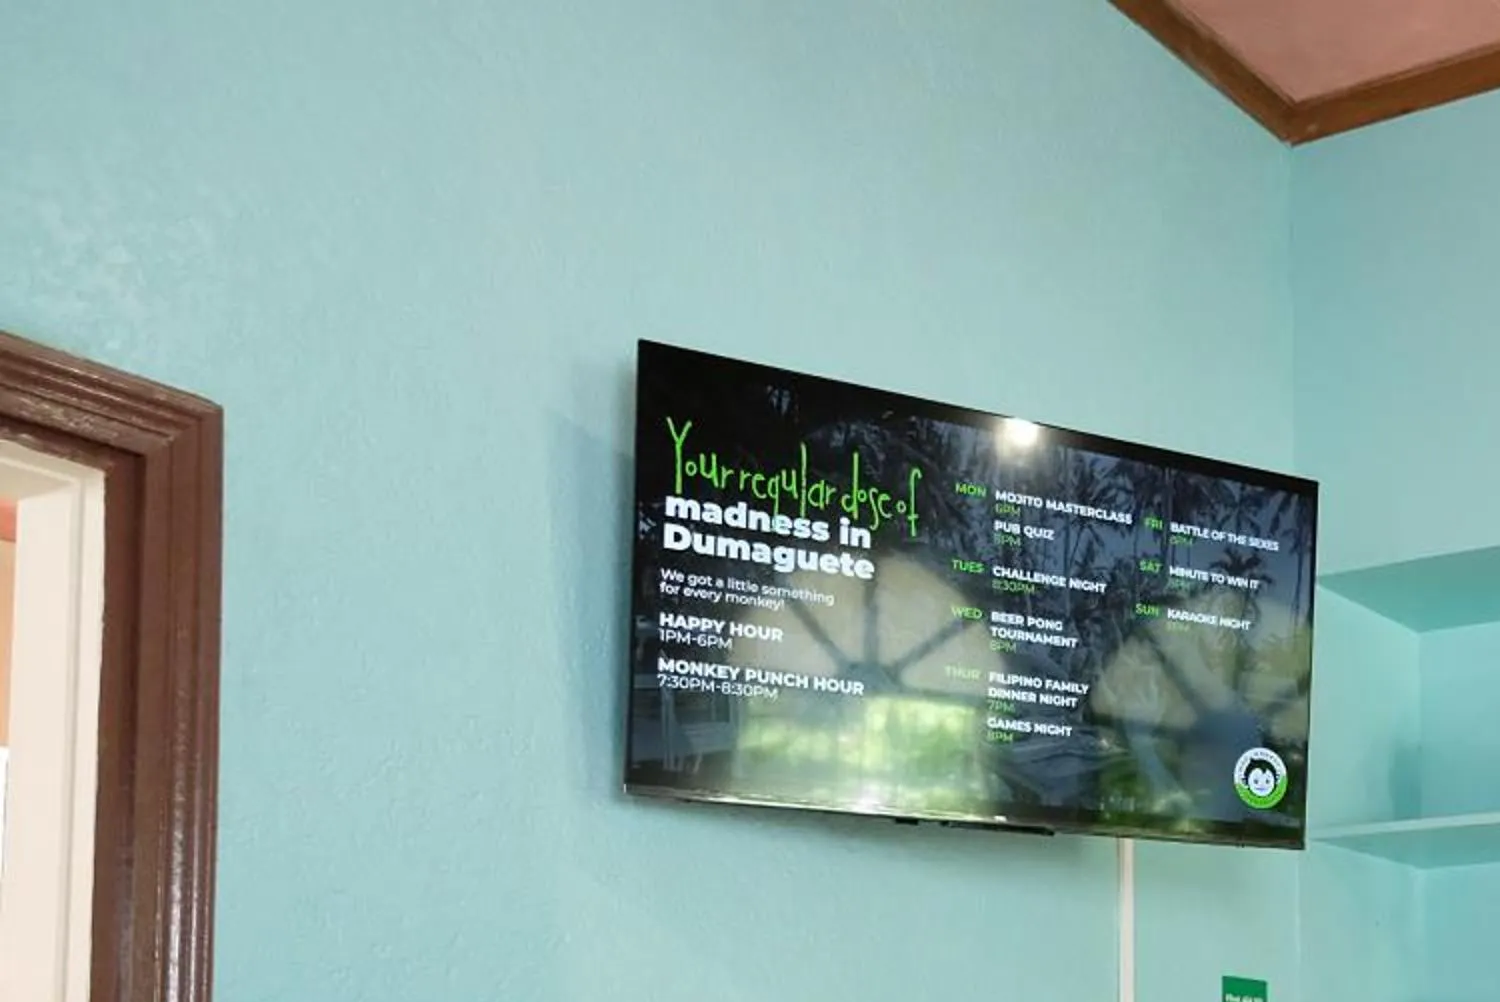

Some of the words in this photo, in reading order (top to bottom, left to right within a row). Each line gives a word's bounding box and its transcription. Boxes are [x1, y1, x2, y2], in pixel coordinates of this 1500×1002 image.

[666, 416, 734, 494] Your
[739, 441, 837, 531] regular
[841, 451, 892, 531] dose
[896, 468, 922, 537] of
[955, 482, 987, 497] MON
[995, 490, 1043, 508] MOJITO
[1045, 498, 1132, 525] MASTERCLASS
[665, 495, 830, 542] madness
[839, 516, 871, 549] in
[994, 520, 1022, 535] PUB
[1023, 524, 1056, 541] QUIZ
[1169, 521, 1209, 538] BATTLE
[1210, 530, 1226, 541] OF
[1227, 533, 1248, 545] THE
[663, 523, 875, 580] Dumaguete
[952, 559, 985, 574] TUES
[1169, 566, 1209, 582] MINUTE
[1211, 572, 1225, 584] TO
[1226, 575, 1249, 589] WIN
[660, 568, 685, 583] We
[687, 573, 712, 588] got
[715, 579, 724, 588] a
[727, 577, 759, 593] little
[761, 585, 835, 607] something
[992, 564, 1066, 588] CHALLENGE
[1069, 577, 1108, 594] NIGHT
[659, 582, 680, 595] for
[683, 587, 722, 602] every
[725, 592, 785, 611] monkey!
[951, 606, 983, 620] WED
[991, 611, 1025, 626] BEER
[1027, 615, 1064, 631] PONG
[1167, 608, 1218, 625] KARAOKE
[1219, 614, 1251, 631] NIGHT
[658, 628, 734, 649] 1PM-6PM
[659, 612, 726, 634] HAPPY
[729, 621, 784, 642] HOUR
[990, 626, 1078, 649] TOURNAMENT
[656, 674, 779, 700] 7:30PM-8:30PM
[657, 658, 740, 681] MONKEY
[745, 669, 809, 689] PUNCH
[813, 675, 865, 696] HOUR
[988, 671, 1043, 689] FILIPINO
[1044, 678, 1090, 695] FAMILY
[988, 687, 1037, 703] DINNER
[1039, 692, 1078, 709] NIGHT
[987, 716, 1032, 733] GAMES
[1033, 722, 1073, 737] NIGHT
